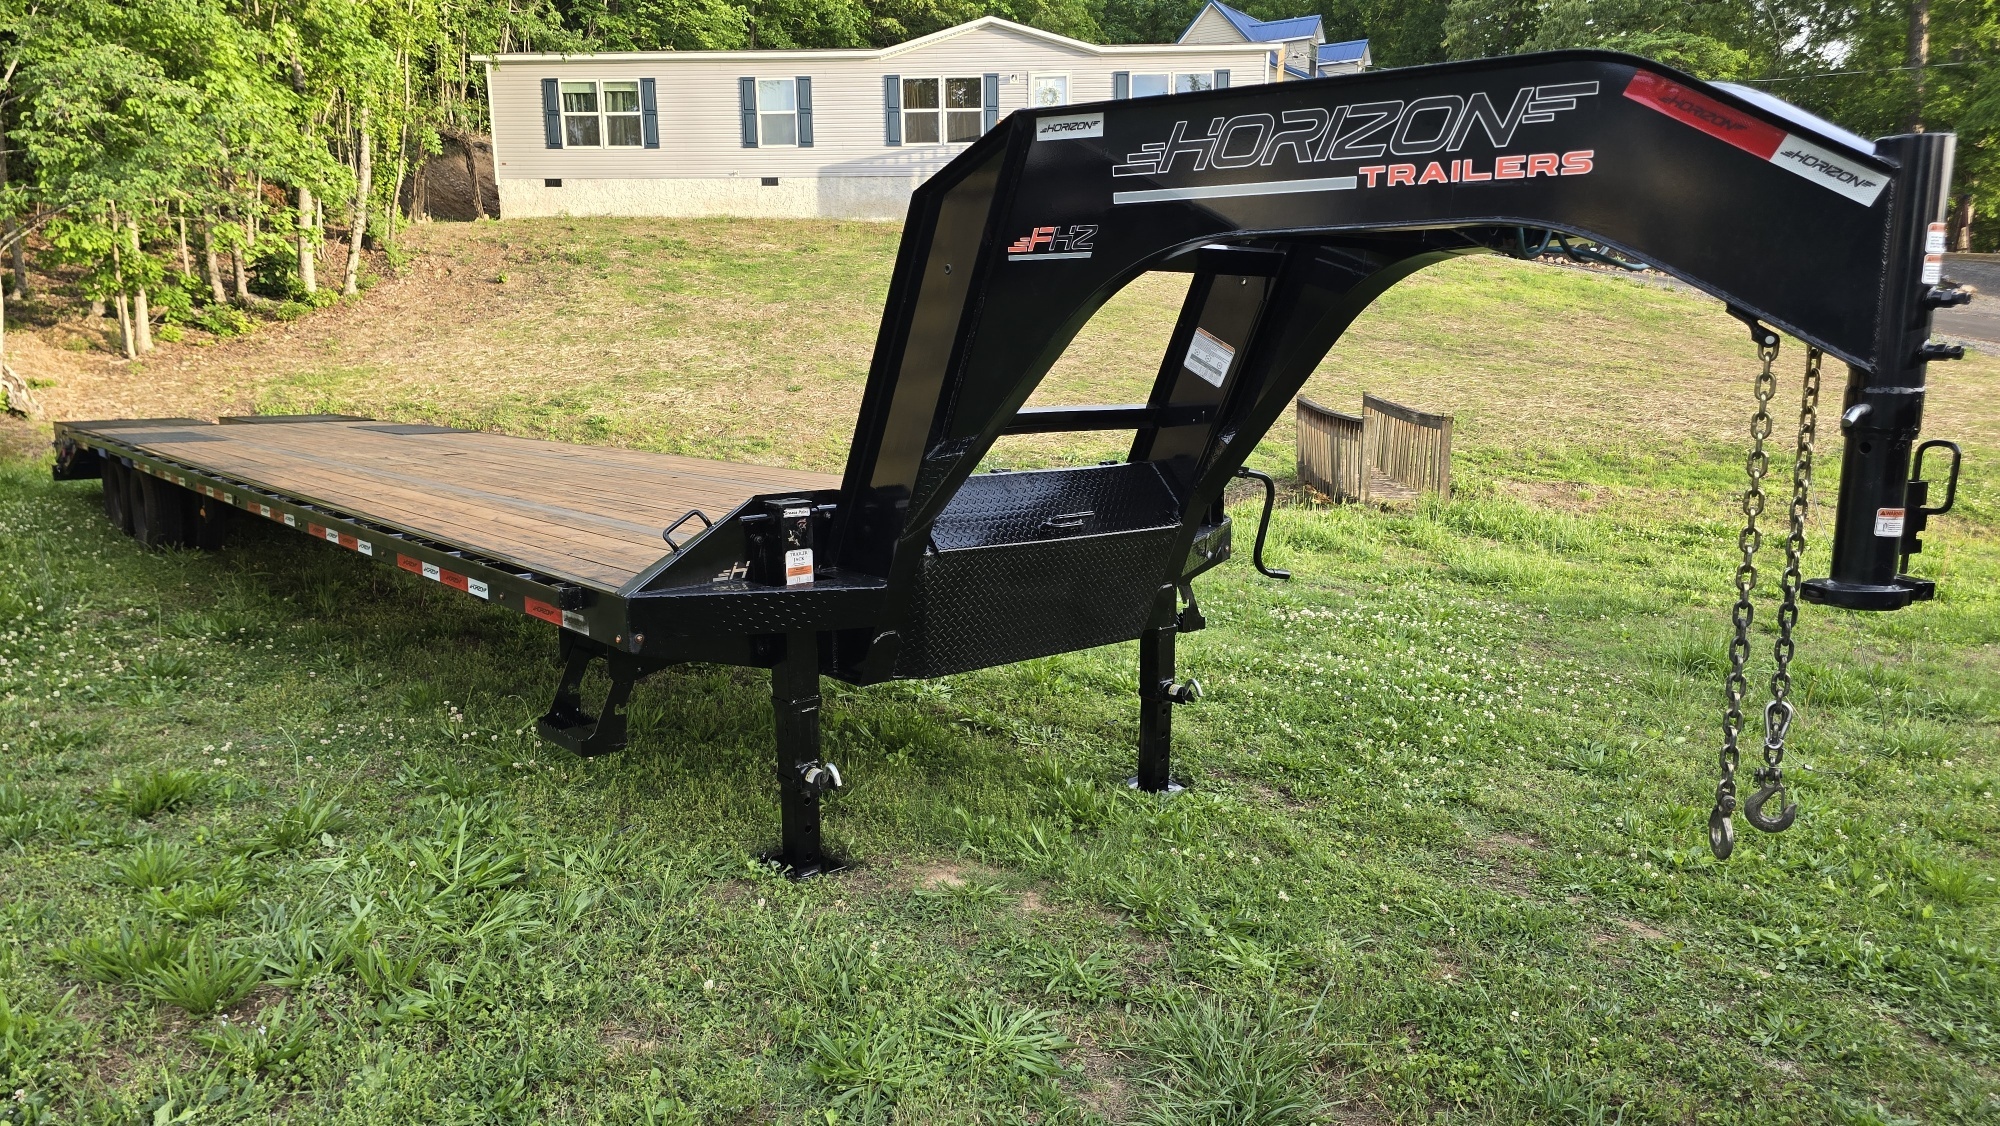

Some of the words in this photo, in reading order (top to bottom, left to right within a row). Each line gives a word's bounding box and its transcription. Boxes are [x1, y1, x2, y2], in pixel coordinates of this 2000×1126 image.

[1046, 120, 1094, 133] HORIZON
[1158, 87, 1534, 173] HORIZON
[1666, 97, 1741, 131] HORIZON
[1359, 149, 1594, 188] TRAILERS
[1787, 150, 1869, 189] HORIZON
